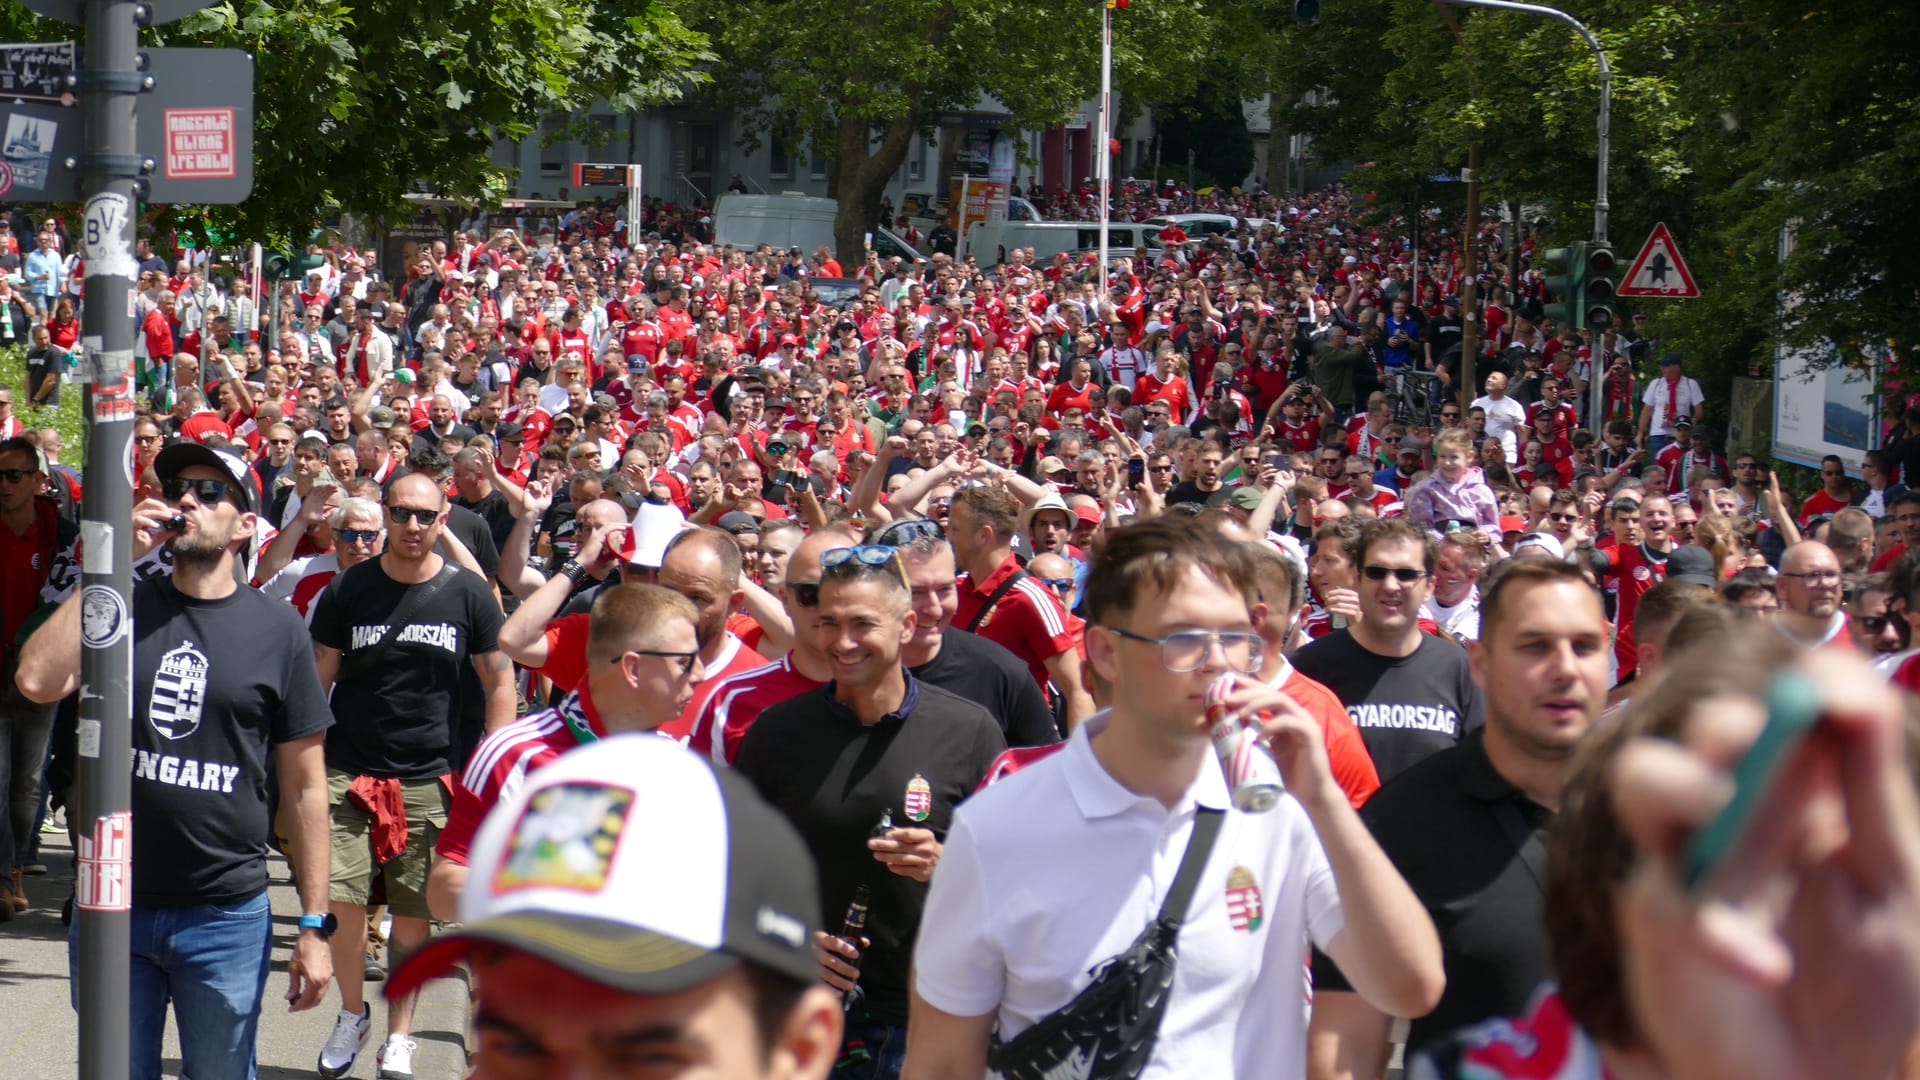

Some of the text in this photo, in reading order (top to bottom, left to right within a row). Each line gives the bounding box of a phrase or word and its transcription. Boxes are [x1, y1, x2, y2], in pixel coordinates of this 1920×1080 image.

[352, 622, 457, 653] MAGYRORSZÁG
[1345, 703, 1456, 735] GYARORSZÁG
[130, 747, 240, 793] NGARY
